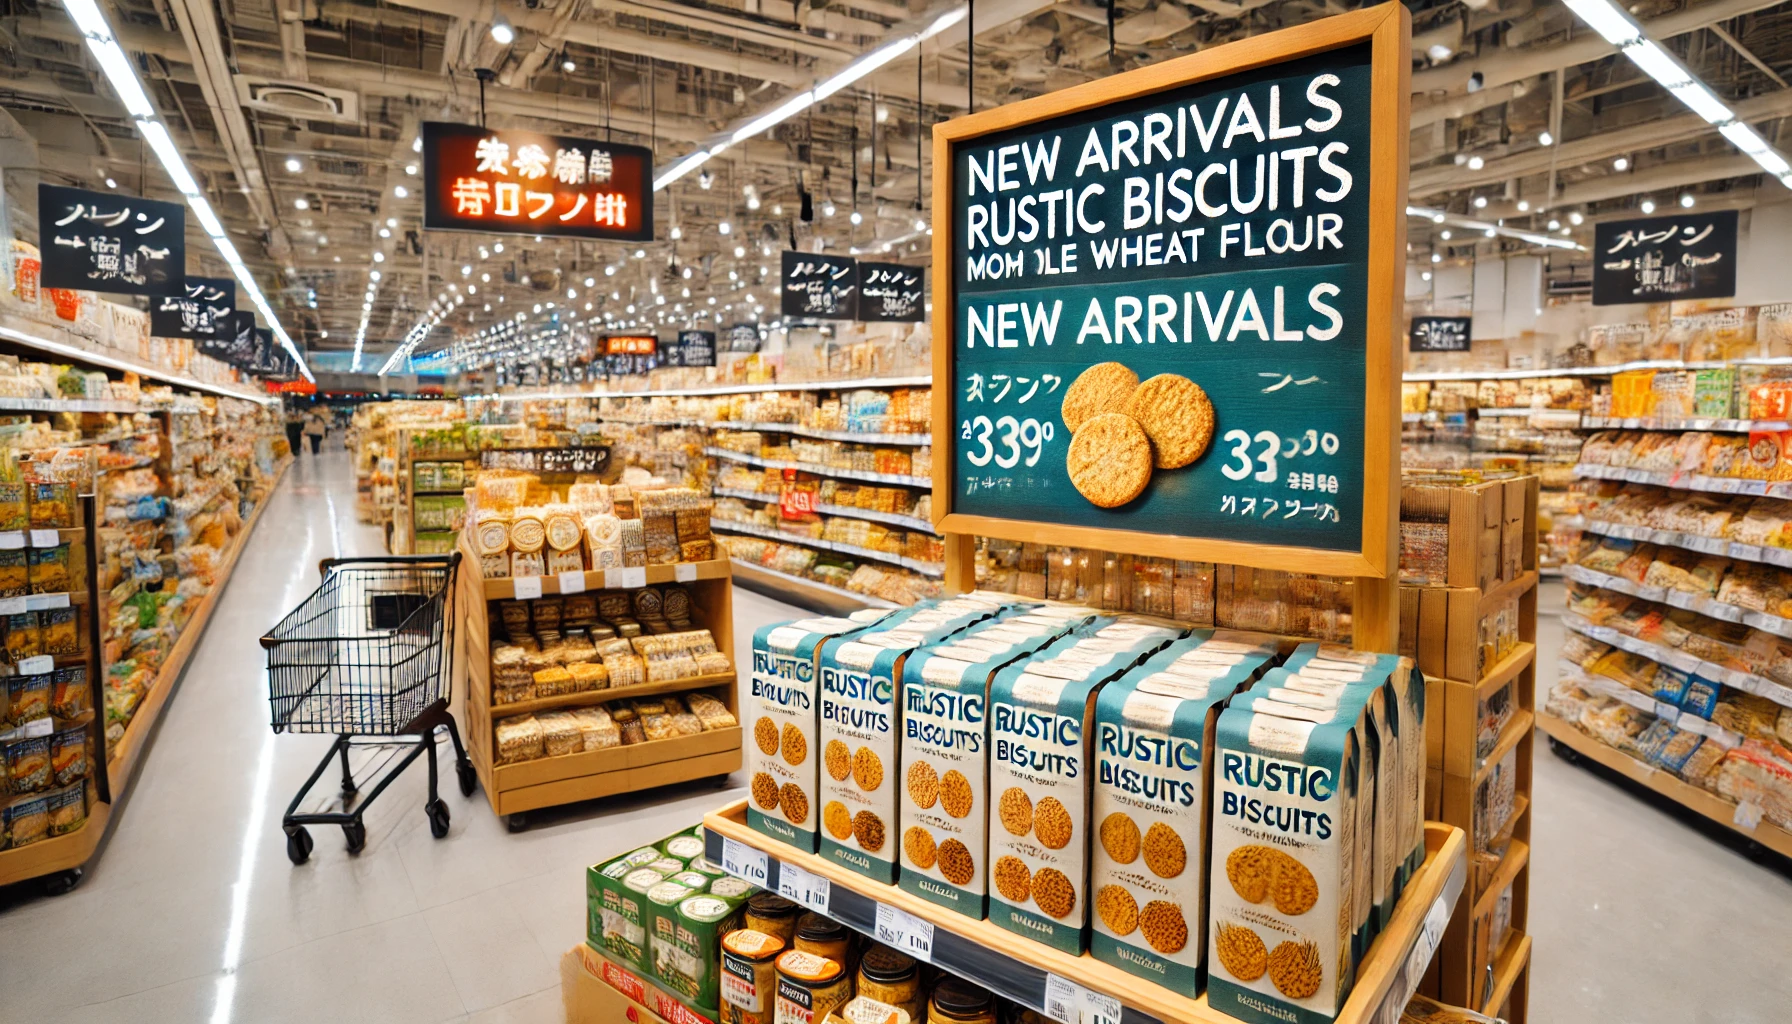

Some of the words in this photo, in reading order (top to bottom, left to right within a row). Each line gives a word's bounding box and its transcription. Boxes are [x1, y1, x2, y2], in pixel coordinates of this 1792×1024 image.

[968, 135, 1061, 196] NEW
[1075, 73, 1342, 178] ARRIVALS
[967, 183, 1106, 249] RUSTIC
[1124, 142, 1353, 230] BISCUITS
[1090, 228, 1205, 271] WHEAT
[1220, 213, 1344, 258] FLOUR
[967, 299, 1063, 349] NEW
[1076, 282, 1344, 345] ARRIVALS
[823, 669, 892, 705] RUSTIC
[996, 706, 1080, 747] RUSTIC
[1100, 725, 1198, 772] RUSTIC
[1224, 752, 1333, 802] RUSTIC
[1222, 790, 1333, 841] BISCUITS
